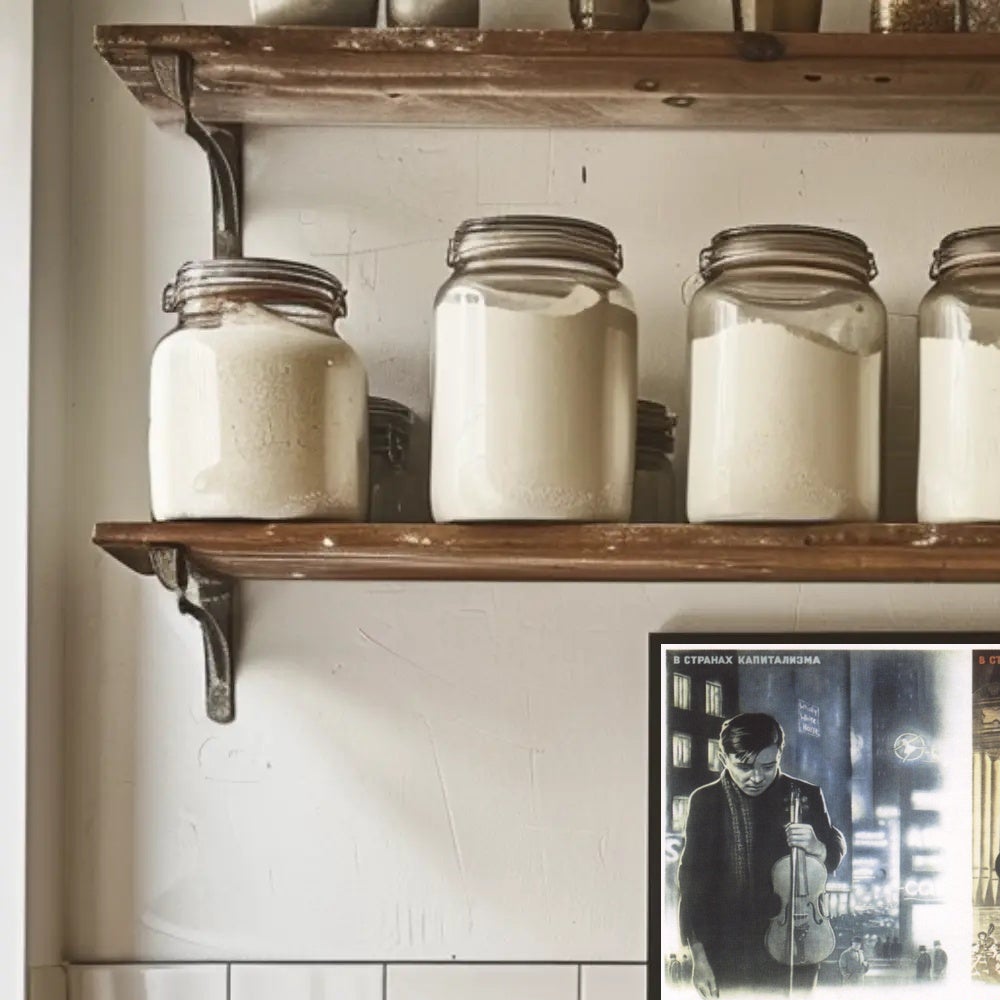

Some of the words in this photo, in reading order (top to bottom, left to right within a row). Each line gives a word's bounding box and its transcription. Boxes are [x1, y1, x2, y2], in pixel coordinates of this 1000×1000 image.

[673, 655, 681, 665] В
[683, 655, 733, 665] СТРАНАХ
[737, 655, 821, 665] КАПИТАЛИЗМА
[978, 655, 986, 665] В
